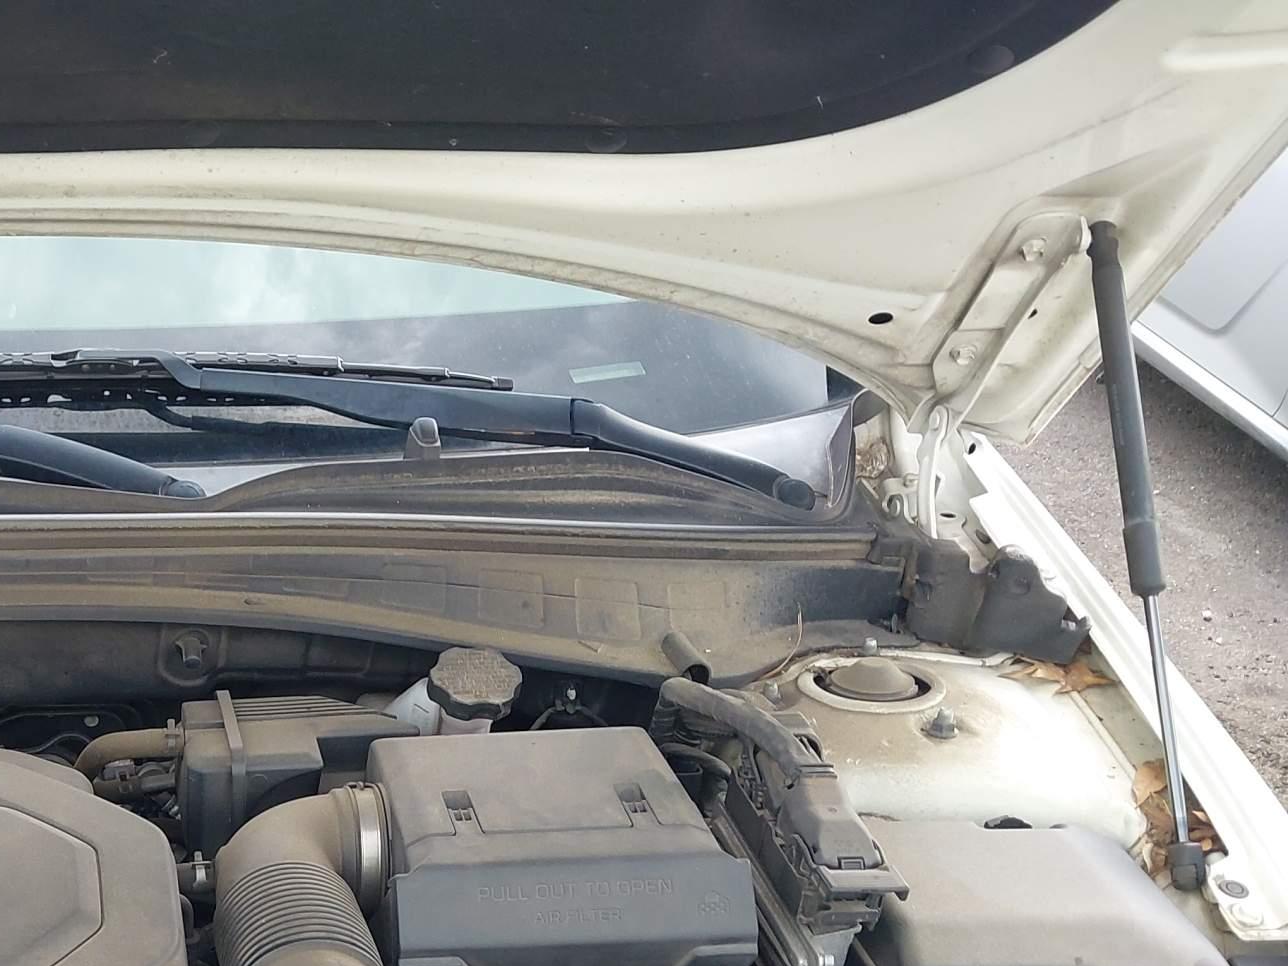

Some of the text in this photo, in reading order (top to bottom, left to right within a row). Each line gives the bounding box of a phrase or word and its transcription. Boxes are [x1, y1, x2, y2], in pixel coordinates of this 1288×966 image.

[478, 878, 673, 902] PULL OUT TO OPEN
[534, 906, 624, 926] AIR FILTER
